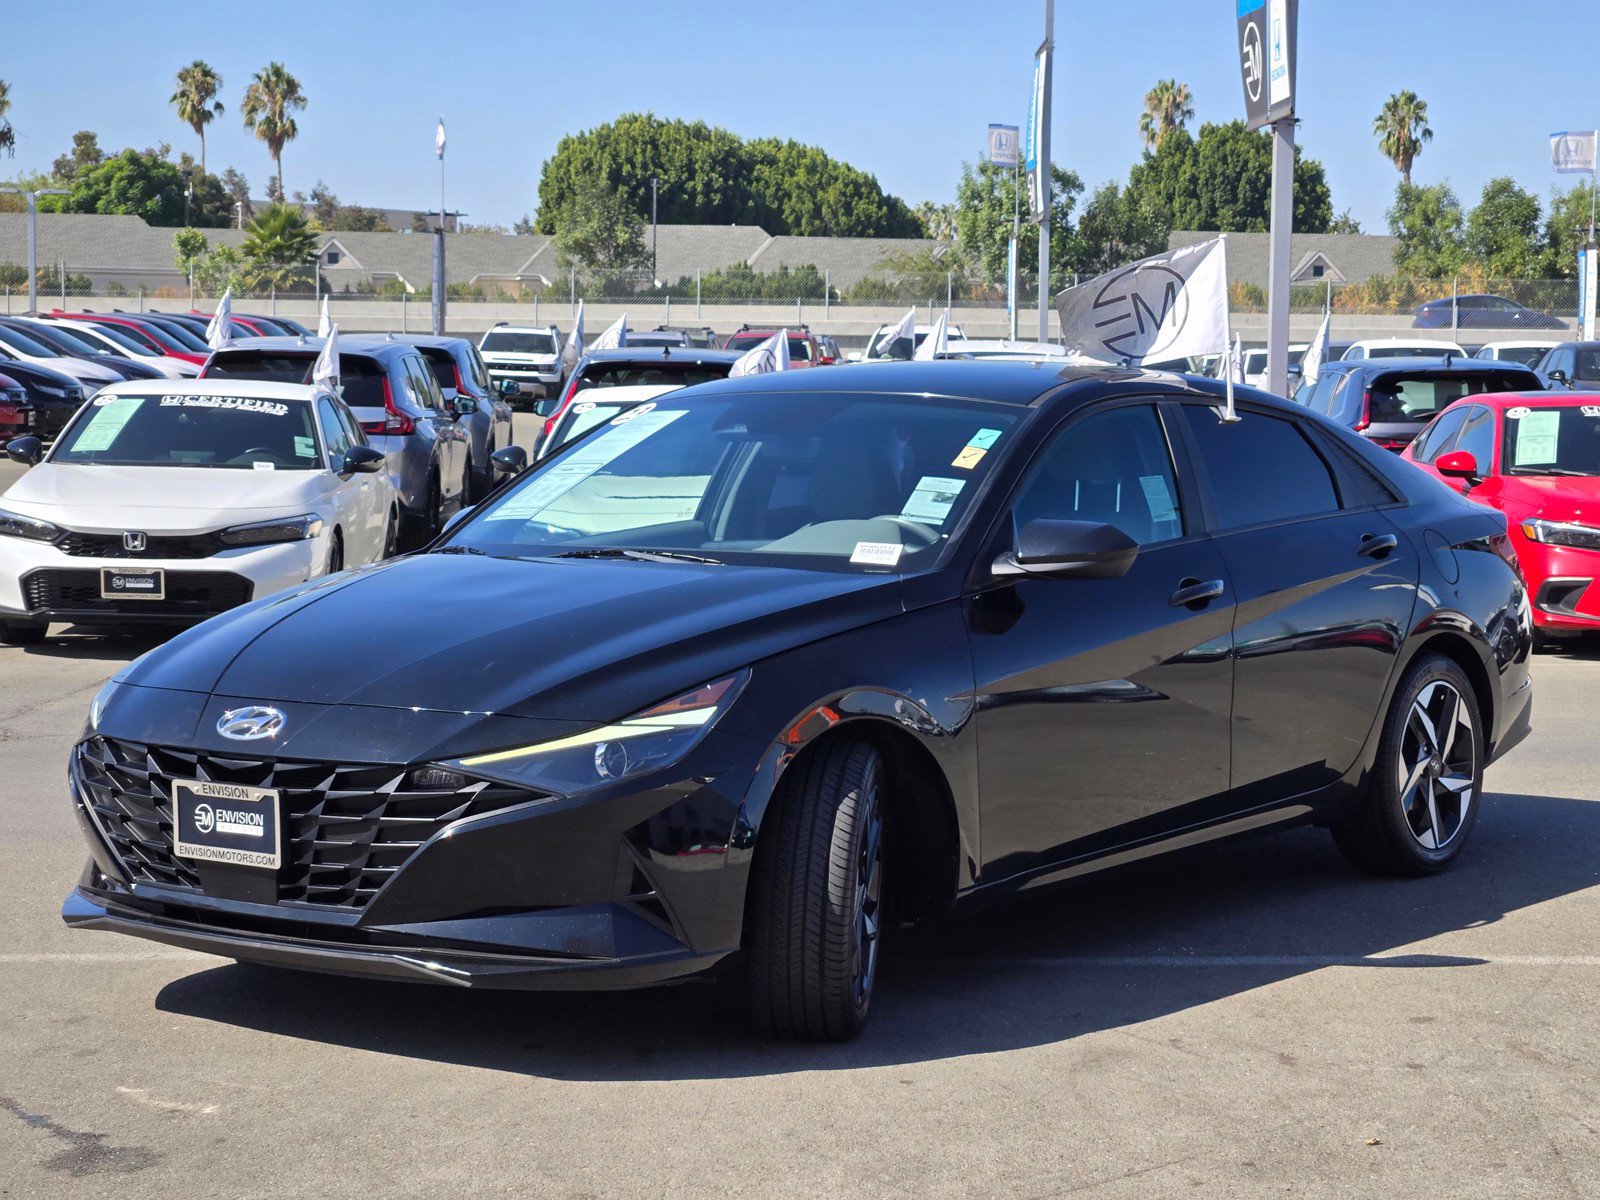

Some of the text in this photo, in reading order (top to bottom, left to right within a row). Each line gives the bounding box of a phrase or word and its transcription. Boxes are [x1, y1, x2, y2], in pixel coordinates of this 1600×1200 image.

[1093, 273, 1183, 352] EM
[183, 395, 289, 412] CERTIFIED
[202, 784, 249, 798] ENVISION
[216, 809, 264, 826] ENVISION
[179, 846, 276, 866] ENVISIONMOTORS.COM
